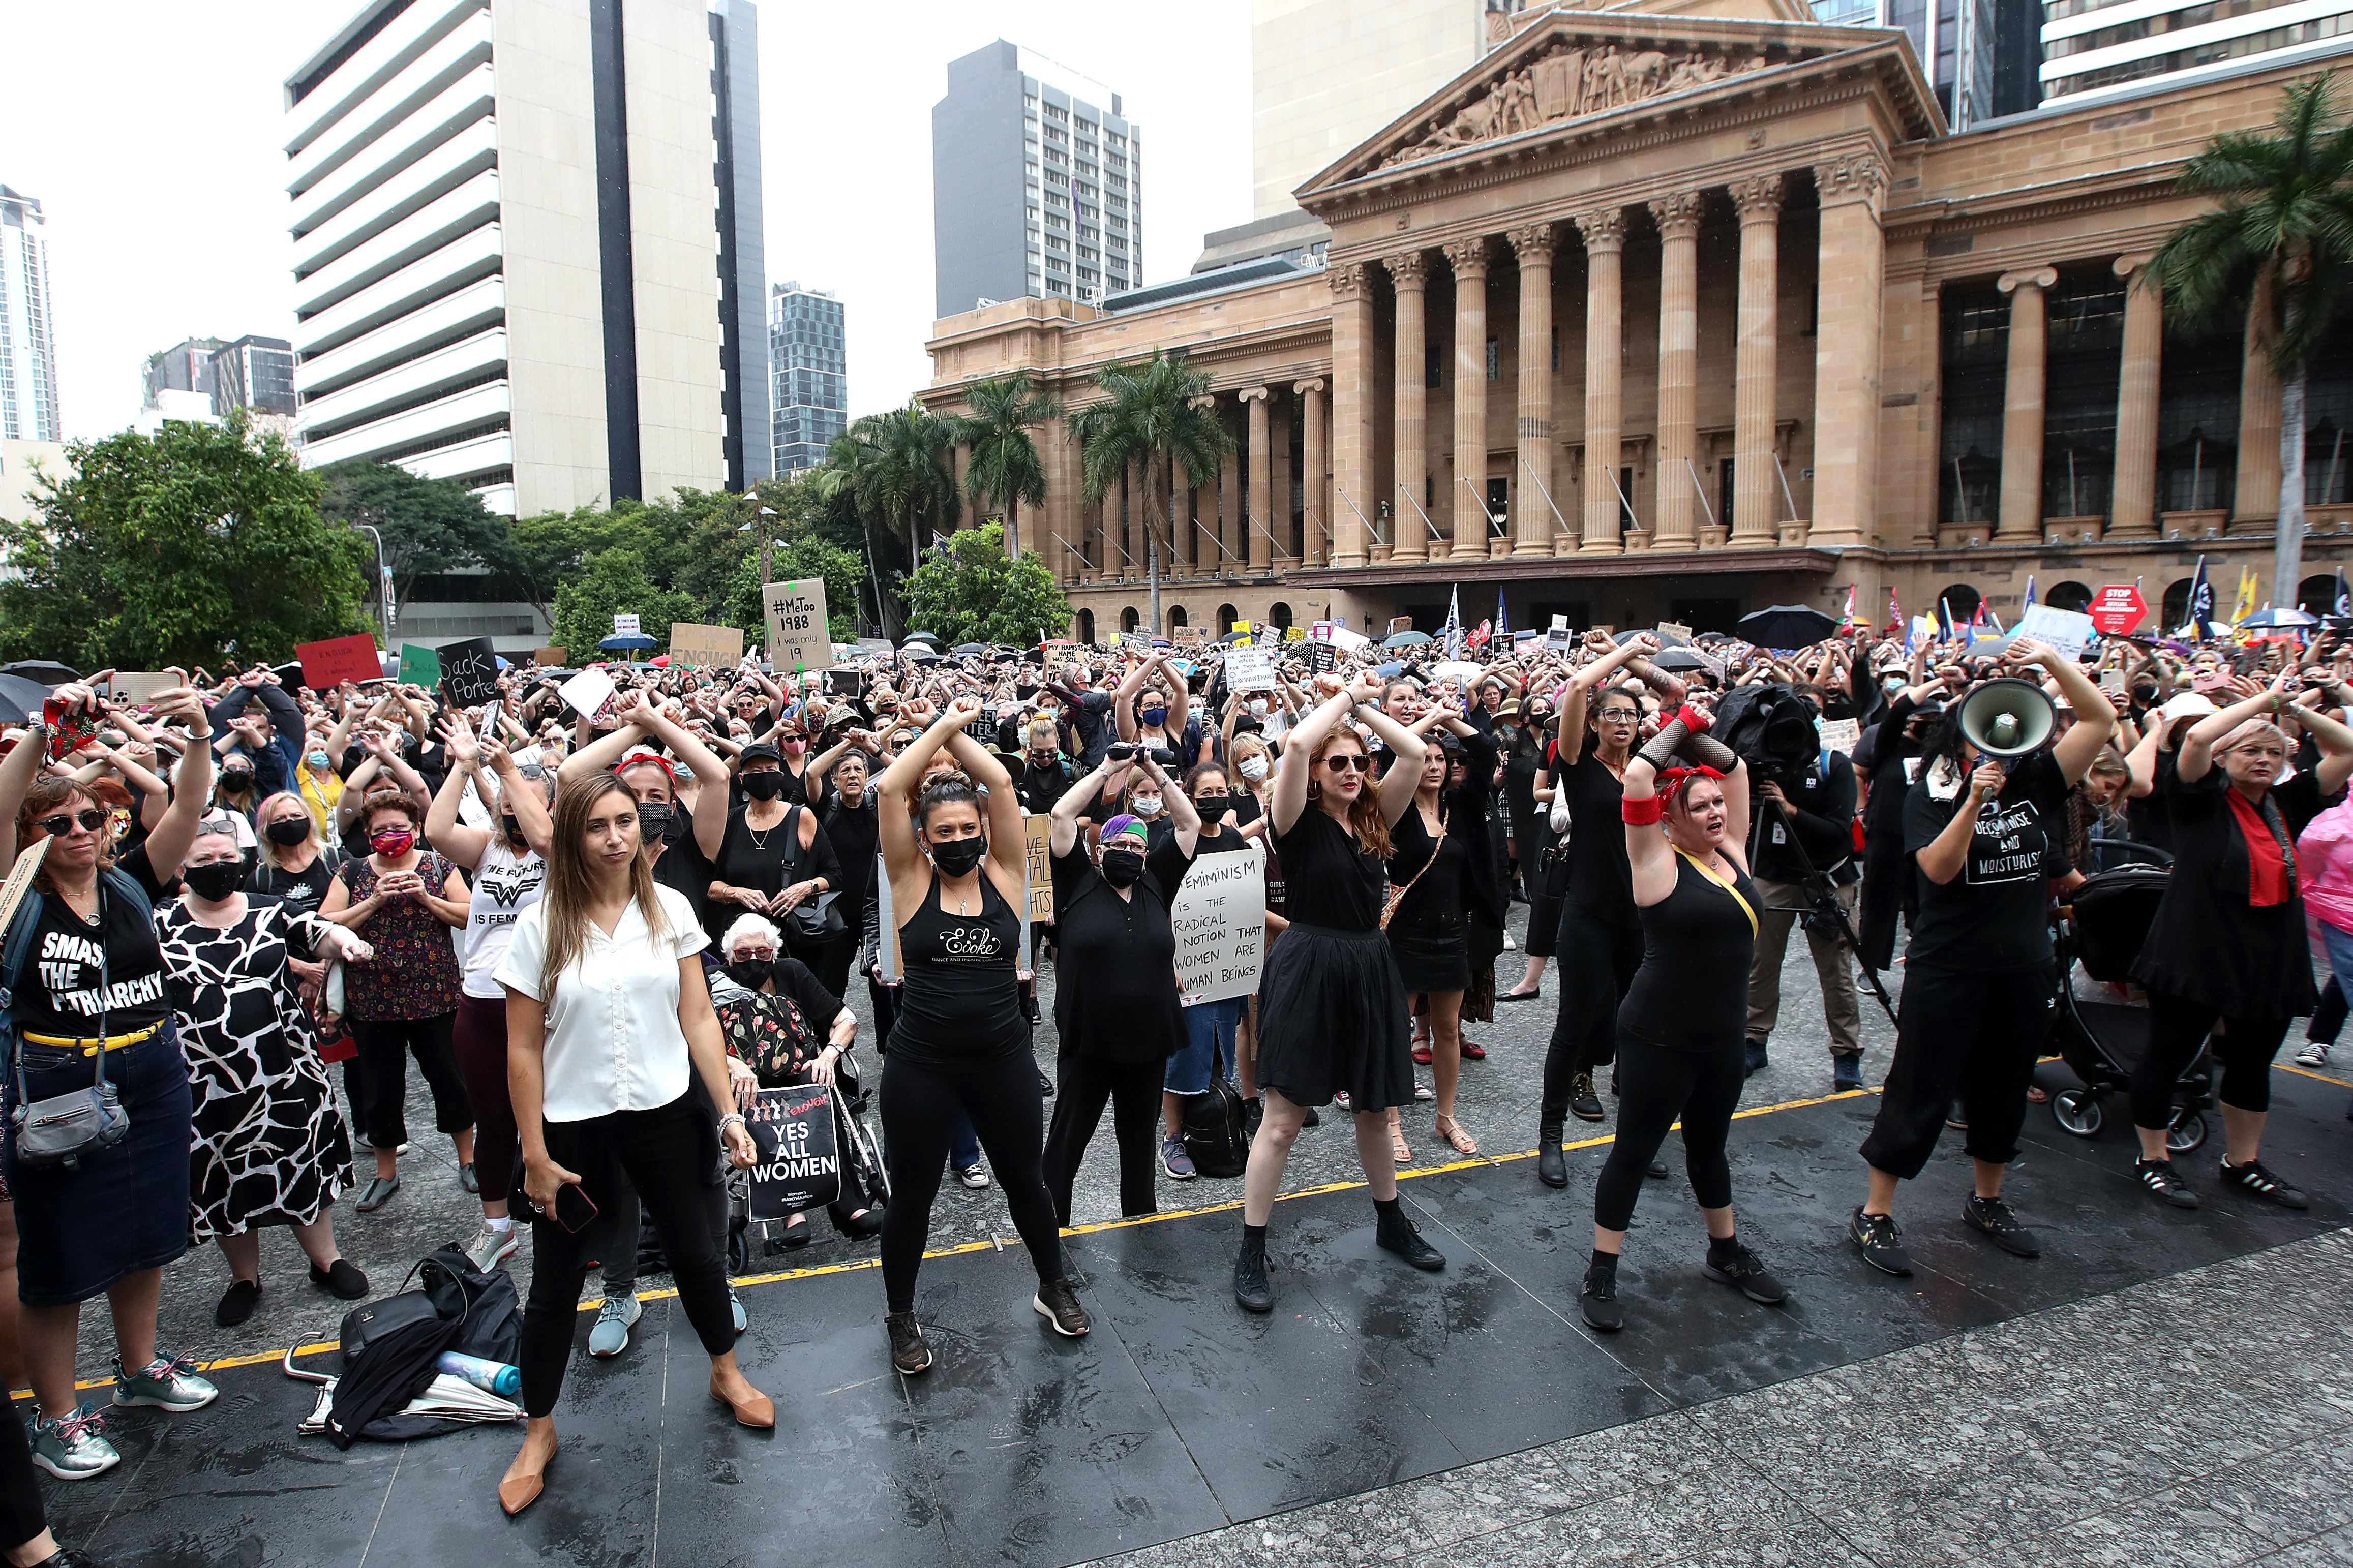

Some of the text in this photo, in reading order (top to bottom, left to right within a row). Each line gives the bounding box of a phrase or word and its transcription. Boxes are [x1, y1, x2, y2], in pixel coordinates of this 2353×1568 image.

[2105, 589, 2132, 597] STOP
[773, 597, 815, 616] #MeToo
[781, 615, 809, 631] 1988
[705, 639, 717, 650] IS
[777, 637, 781, 646] I
[801, 634, 817, 645] only
[319, 647, 353, 659] ENOUGH
[671, 649, 741, 667] ENOUGH
[790, 647, 803, 660] 19
[438, 649, 490, 680] Sack
[2001, 835, 2020, 852] AND
[506, 860, 546, 878] FUTURE
[1205, 896, 1226, 907] THE
[475, 914, 485, 924] IS
[939, 928, 1001, 955] Evoke
[1235, 926, 1262, 940] THAT
[41, 932, 106, 970] SMAS
[1174, 943, 1256, 970] WOMEN ARE
[39, 961, 81, 990] THE
[789, 1093, 829, 1116] ENOUGH!
[771, 1121, 809, 1143] YES
[774, 1140, 811, 1161] ALL
[751, 1155, 836, 1183] WOMEN
